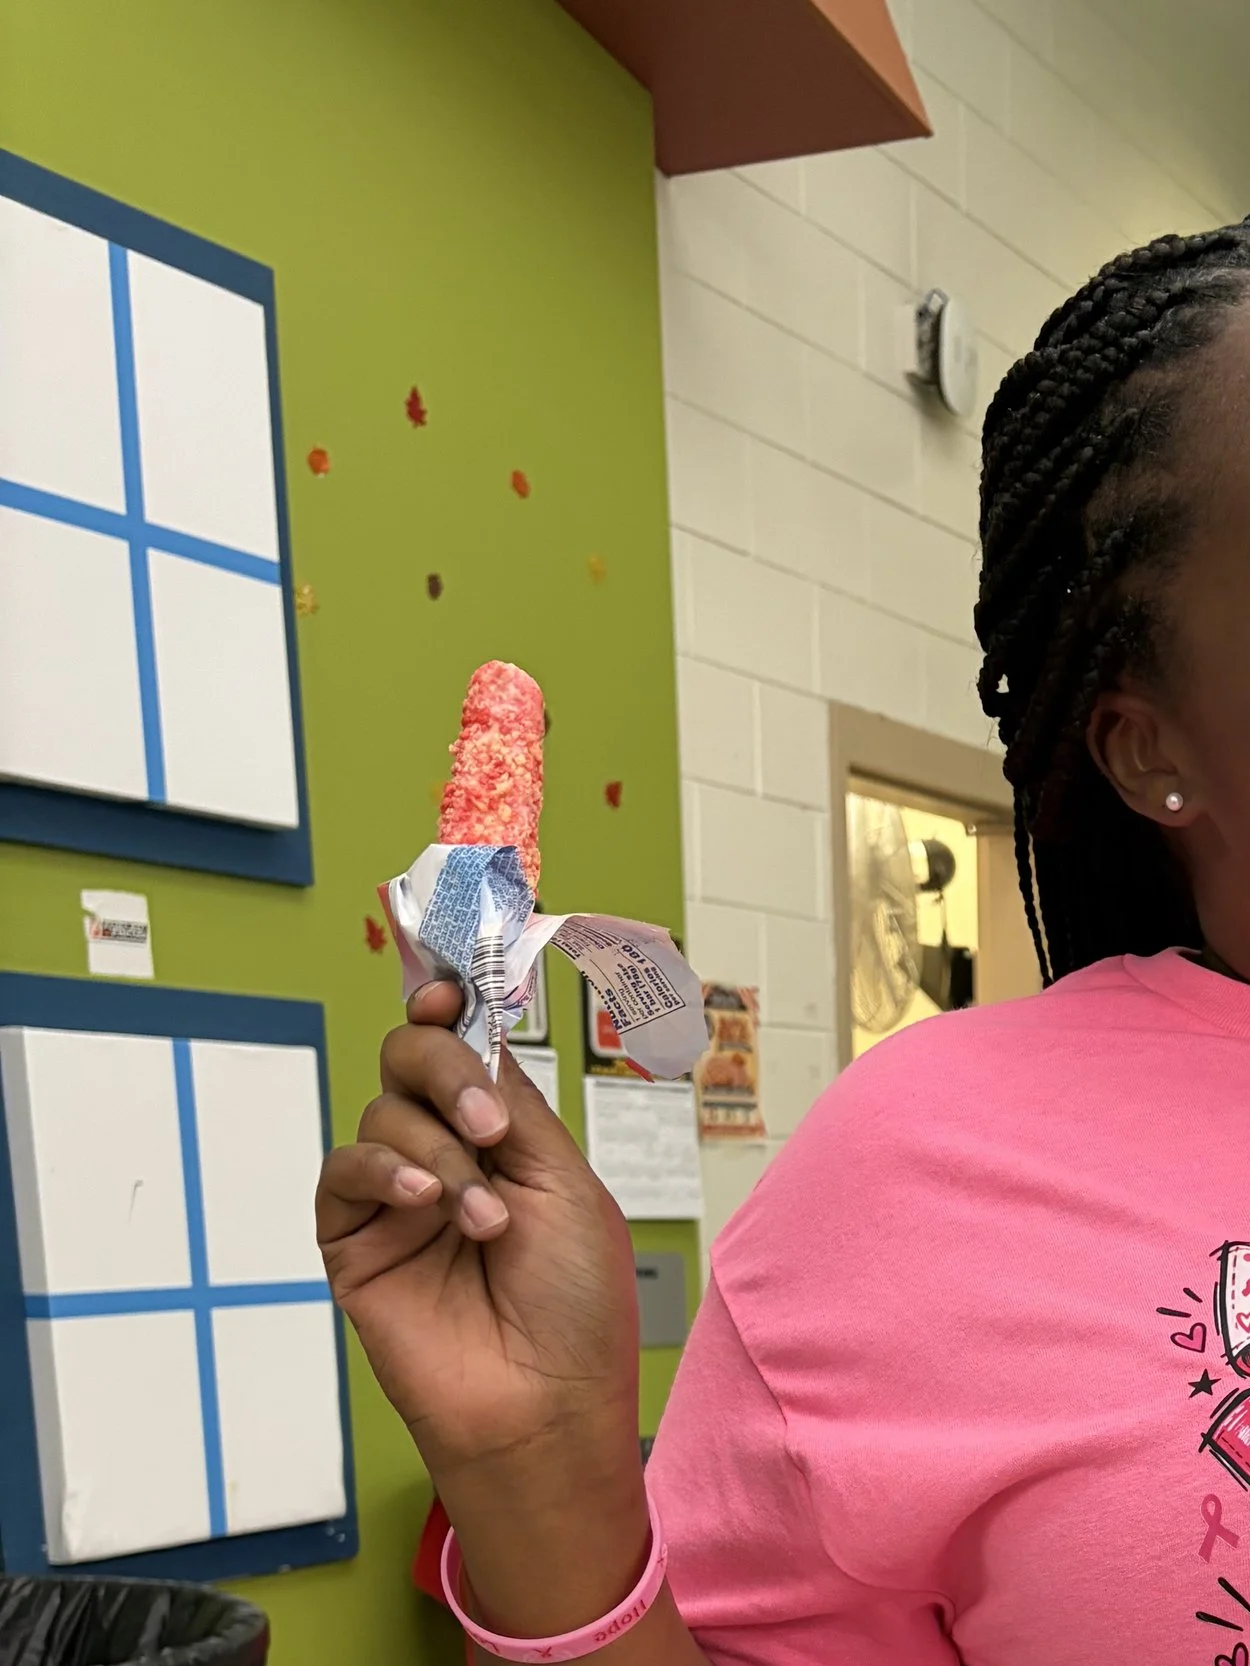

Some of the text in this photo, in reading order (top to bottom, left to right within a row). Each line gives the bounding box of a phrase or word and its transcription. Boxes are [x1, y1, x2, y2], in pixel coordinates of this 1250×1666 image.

[617, 963, 655, 1016] Serving size
[621, 944, 673, 1010] Calories 180
[628, 964, 646, 988] (78g)
[605, 988, 632, 1027] Facts
[615, 971, 648, 1020] per container
[618, 988, 637, 1015] serving
[642, 990, 656, 1007] bar
[668, 992, 681, 1006] per
